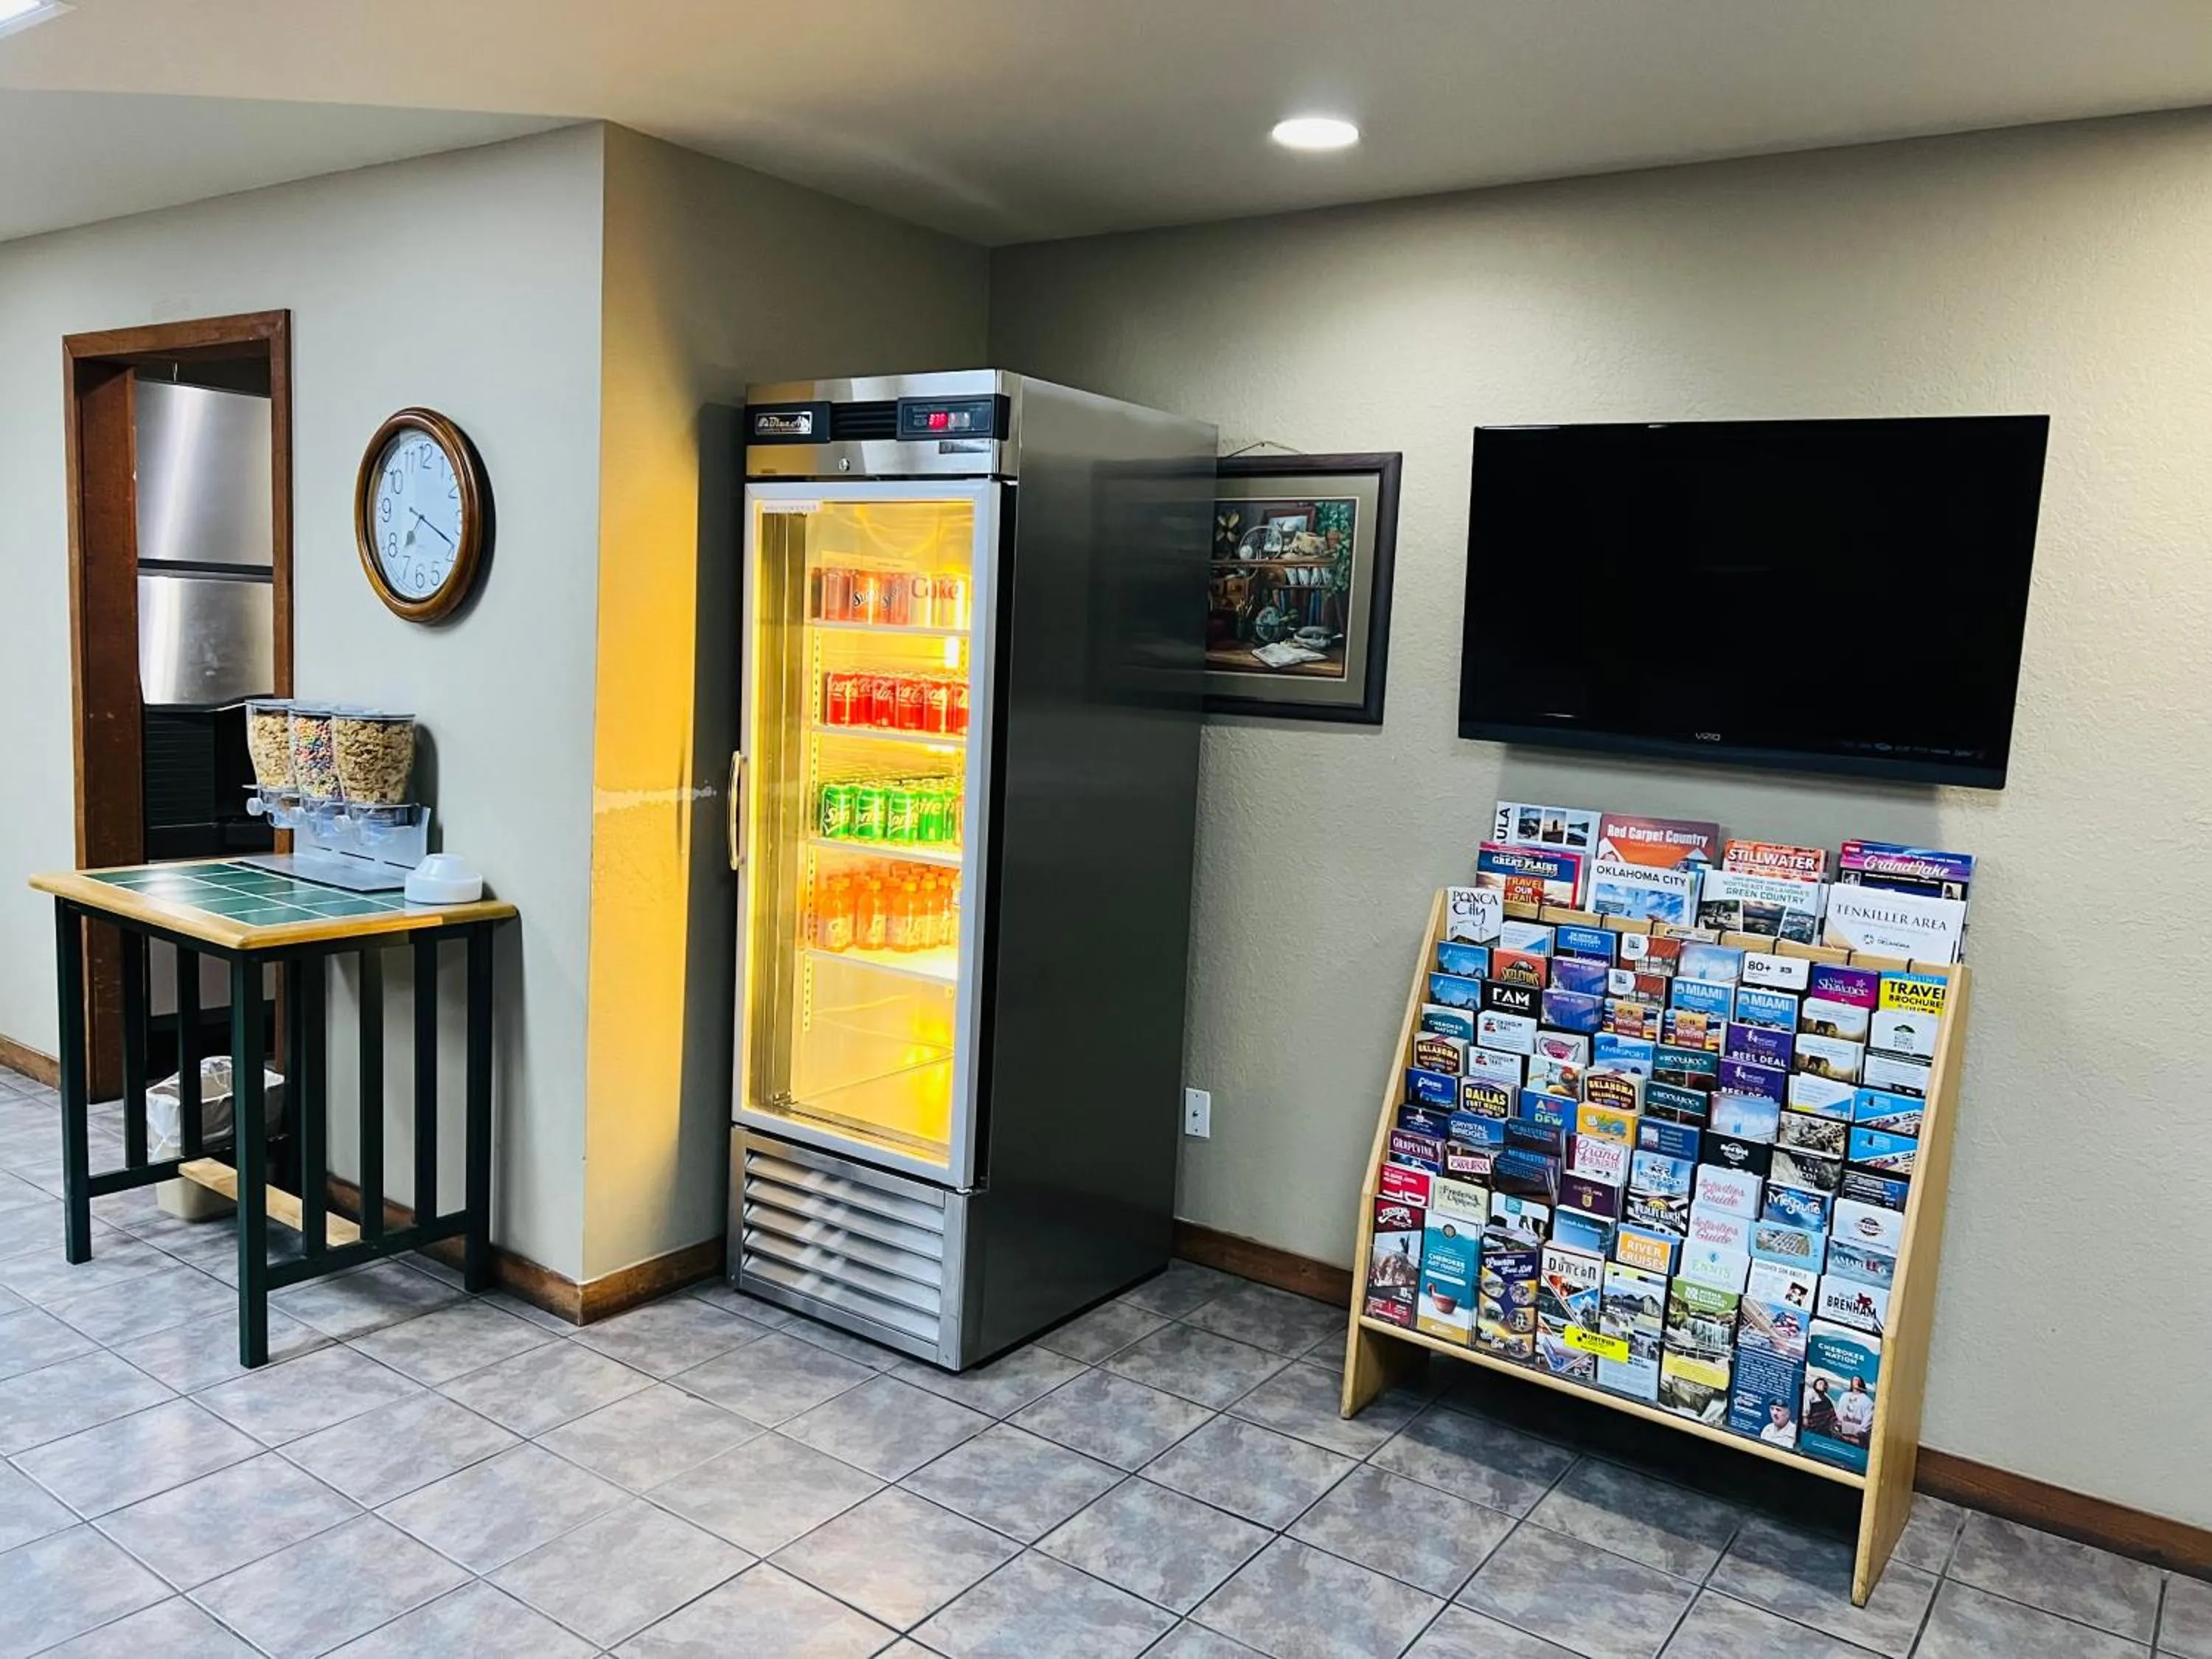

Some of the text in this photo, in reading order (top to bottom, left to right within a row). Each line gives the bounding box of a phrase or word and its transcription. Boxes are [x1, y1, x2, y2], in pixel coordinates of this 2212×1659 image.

[404, 451, 416, 473] 11
[419, 443, 434, 470] 12
[389, 469, 404, 495] 10
[381, 498, 392, 523] 9
[388, 532, 397, 558] 8
[401, 555, 411, 580] 7
[430, 561, 441, 587] 5
[415, 565, 425, 589] 6
[1607, 824, 1627, 838] Red
[1629, 827, 1663, 844] Carpet
[1666, 830, 1708, 848] Country
[1728, 849, 1815, 870] STILLWATER
[1864, 855, 1915, 872] Grand
[1916, 860, 1950, 878] Lake
[1506, 877, 1542, 888] TRAVEL
[1596, 865, 1686, 886] OKLAHOMA CITY
[1452, 891, 1498, 906] PONCA
[1506, 893, 1540, 905] TRAILS
[1514, 886, 1533, 894] OUR
[1726, 887, 1805, 905] GREEN COUNTRY
[1453, 901, 1486, 926] City
[1835, 903, 1947, 932] TENKILLER AREA
[1747, 960, 1771, 972] 80+
[1500, 967, 1540, 985] SKELETONS
[1686, 984, 1722, 1000] MIAMI
[1751, 995, 1790, 1010] MIAMI
[1732, 1051, 1786, 1067] REEL DEAL
[1465, 1088, 1506, 1105] DALLAS
[1589, 1080, 1634, 1096] OKLAHOMA
[1466, 1099, 1505, 1113] FORT WORTH
[1451, 1120, 1486, 1133] CRYSTAL
[1534, 1113, 1563, 1127] DFW
[1393, 1138, 1433, 1157] GRAPEVINE
[1627, 1240, 1662, 1257] RIVER
[1620, 1251, 1666, 1269] CRUISES
[1827, 1295, 1877, 1318] BRENHAM
[1818, 1343, 1865, 1362] CHEROKEE
[1825, 1351, 1857, 1366] NATION
